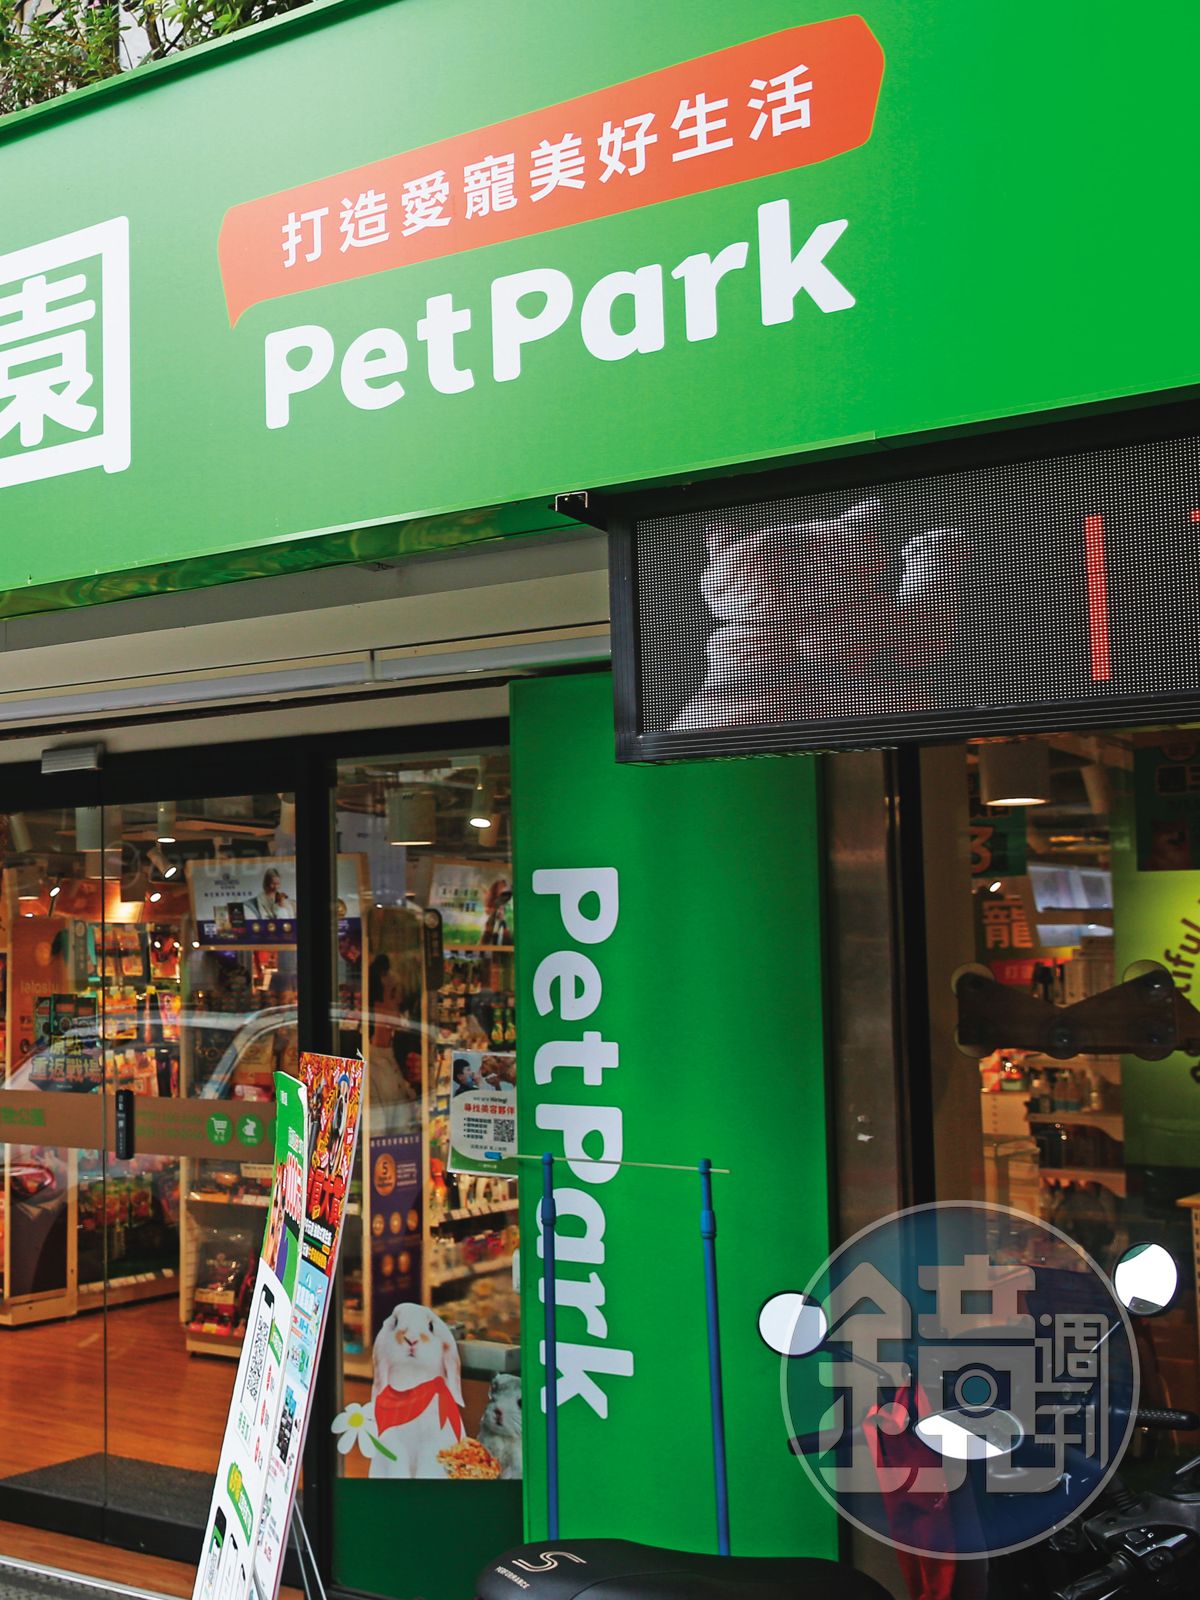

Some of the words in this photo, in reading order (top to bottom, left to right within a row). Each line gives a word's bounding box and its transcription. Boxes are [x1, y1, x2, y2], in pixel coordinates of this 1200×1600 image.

[281, 63, 813, 268] 打造愛寵美好生活
[265, 198, 856, 429] PetPark
[532, 867, 635, 1418] PetPark
